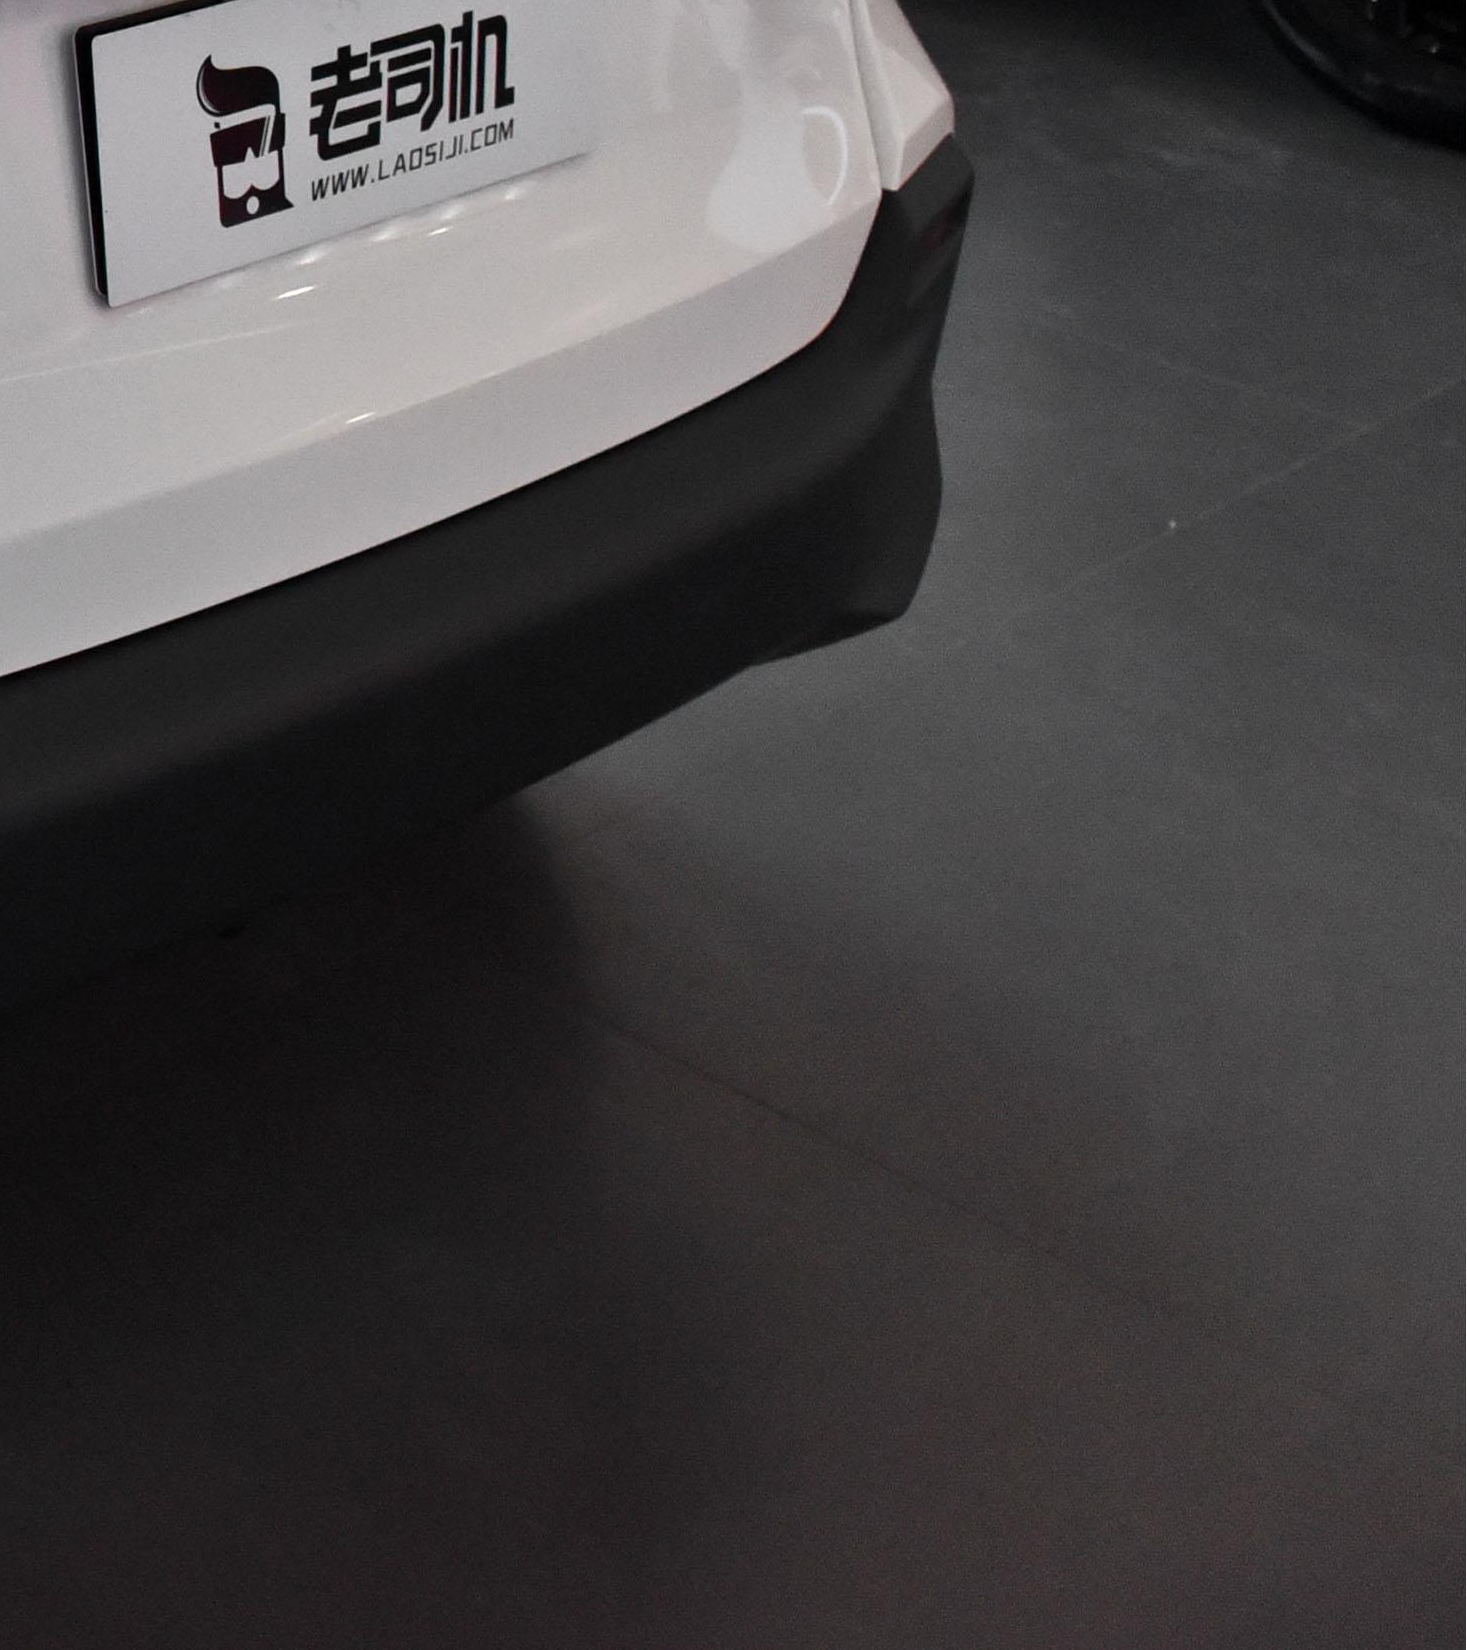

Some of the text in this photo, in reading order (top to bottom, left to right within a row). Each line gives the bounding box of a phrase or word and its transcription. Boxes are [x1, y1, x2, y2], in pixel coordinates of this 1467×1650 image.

[310, 9, 516, 161] 老司机
[310, 117, 516, 202] WWW.LAOSIJI.COM
